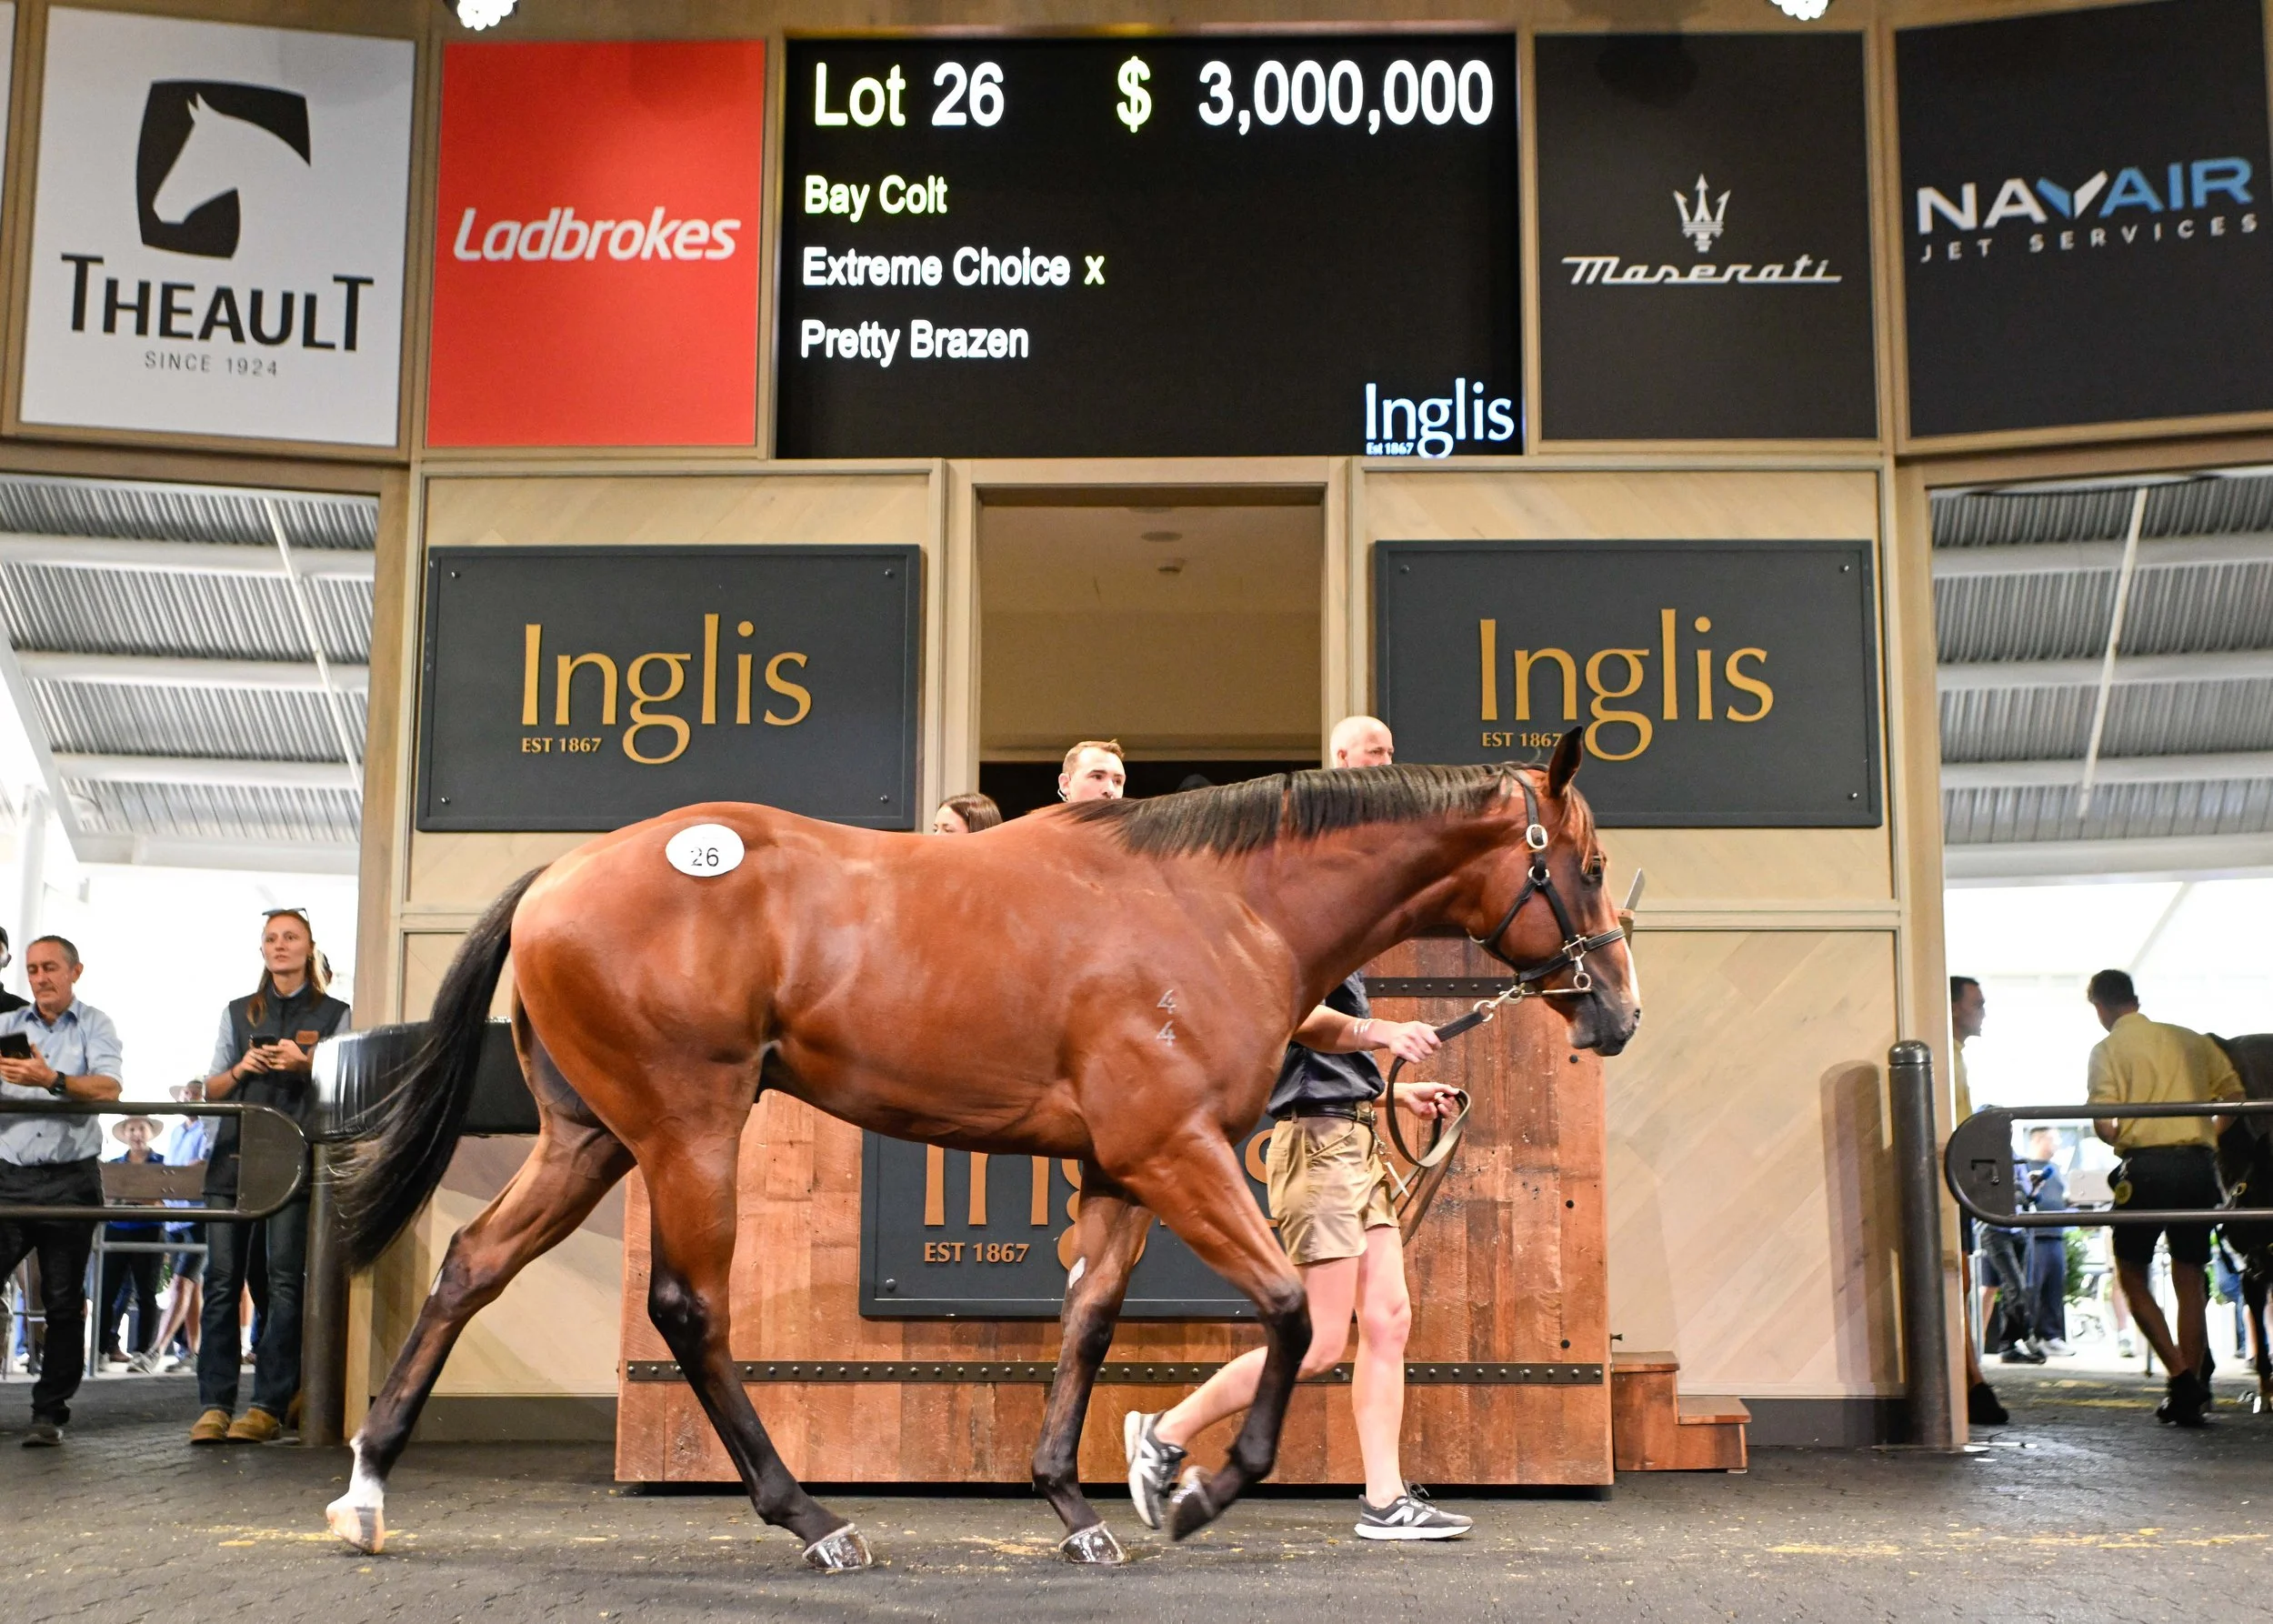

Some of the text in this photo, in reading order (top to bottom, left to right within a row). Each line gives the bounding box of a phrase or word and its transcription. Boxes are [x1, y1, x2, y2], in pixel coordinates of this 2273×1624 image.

[815, 55, 1494, 136] Lot 26 $ 3,000,000
[804, 174, 948, 224] Bay Colt
[453, 206, 742, 262] Ladbrokes
[1919, 212, 2258, 264] JET SERVICES
[802, 246, 1106, 286] Extreme Choice x
[1561, 254, 1843, 286] Maserati
[60, 252, 375, 353] THEAULT
[143, 349, 279, 377] SINCE 1924
[800, 318, 1029, 368] Pretty Brazen
[1365, 377, 1515, 458] Inglis
[1366, 442, 1415, 456] Est 1867
[521, 613, 812, 765] Inglis
[1479, 608, 1774, 761] Inglis
[521, 737, 602, 754] EST 1867
[1482, 731, 1564, 747] EST 1867
[690, 847, 719, 867] 26
[1156, 1018, 1177, 1048] 4
[923, 1241, 1030, 1263] EST 1867
